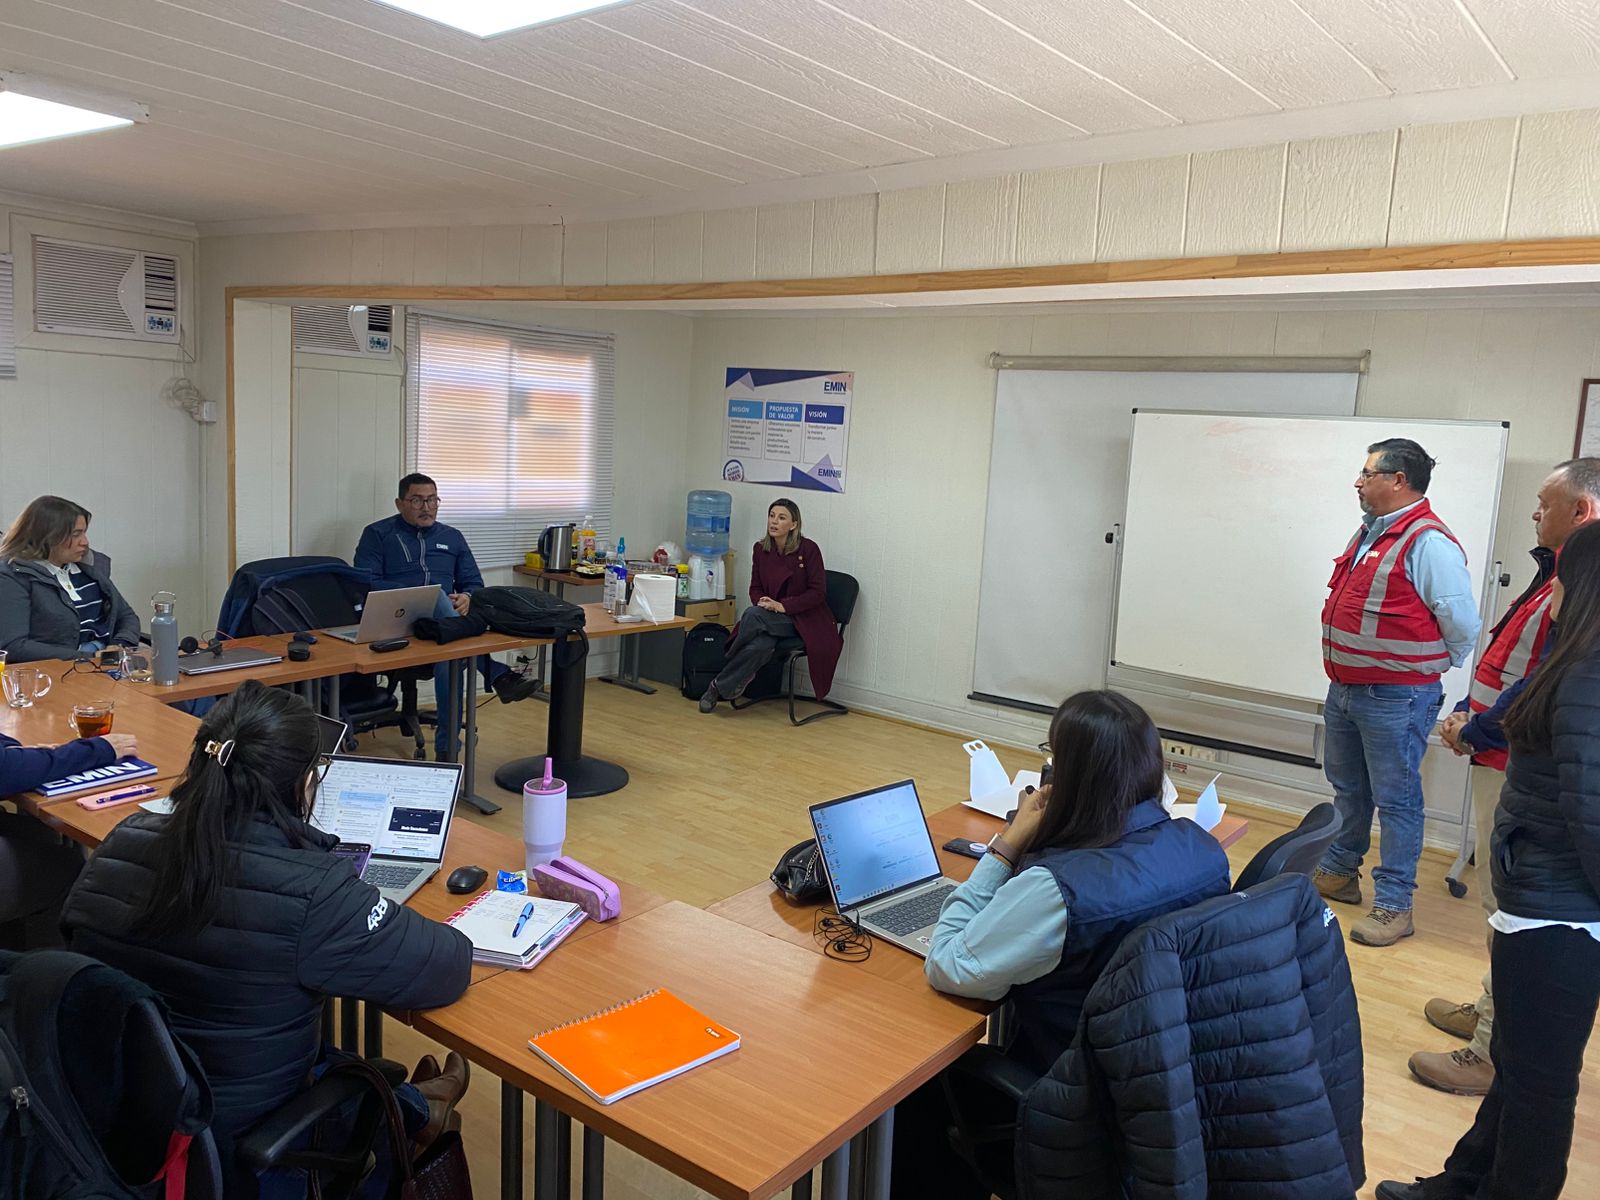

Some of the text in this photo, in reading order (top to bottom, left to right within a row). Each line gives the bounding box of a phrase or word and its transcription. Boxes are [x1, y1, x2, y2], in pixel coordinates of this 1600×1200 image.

[824, 381, 847, 392] EMIN
[769, 405, 799, 413] PROPUESTA
[777, 412, 795, 420] VALOR
[808, 410, 827, 419] VISIÓN
[41, 762, 142, 788] EMIN
